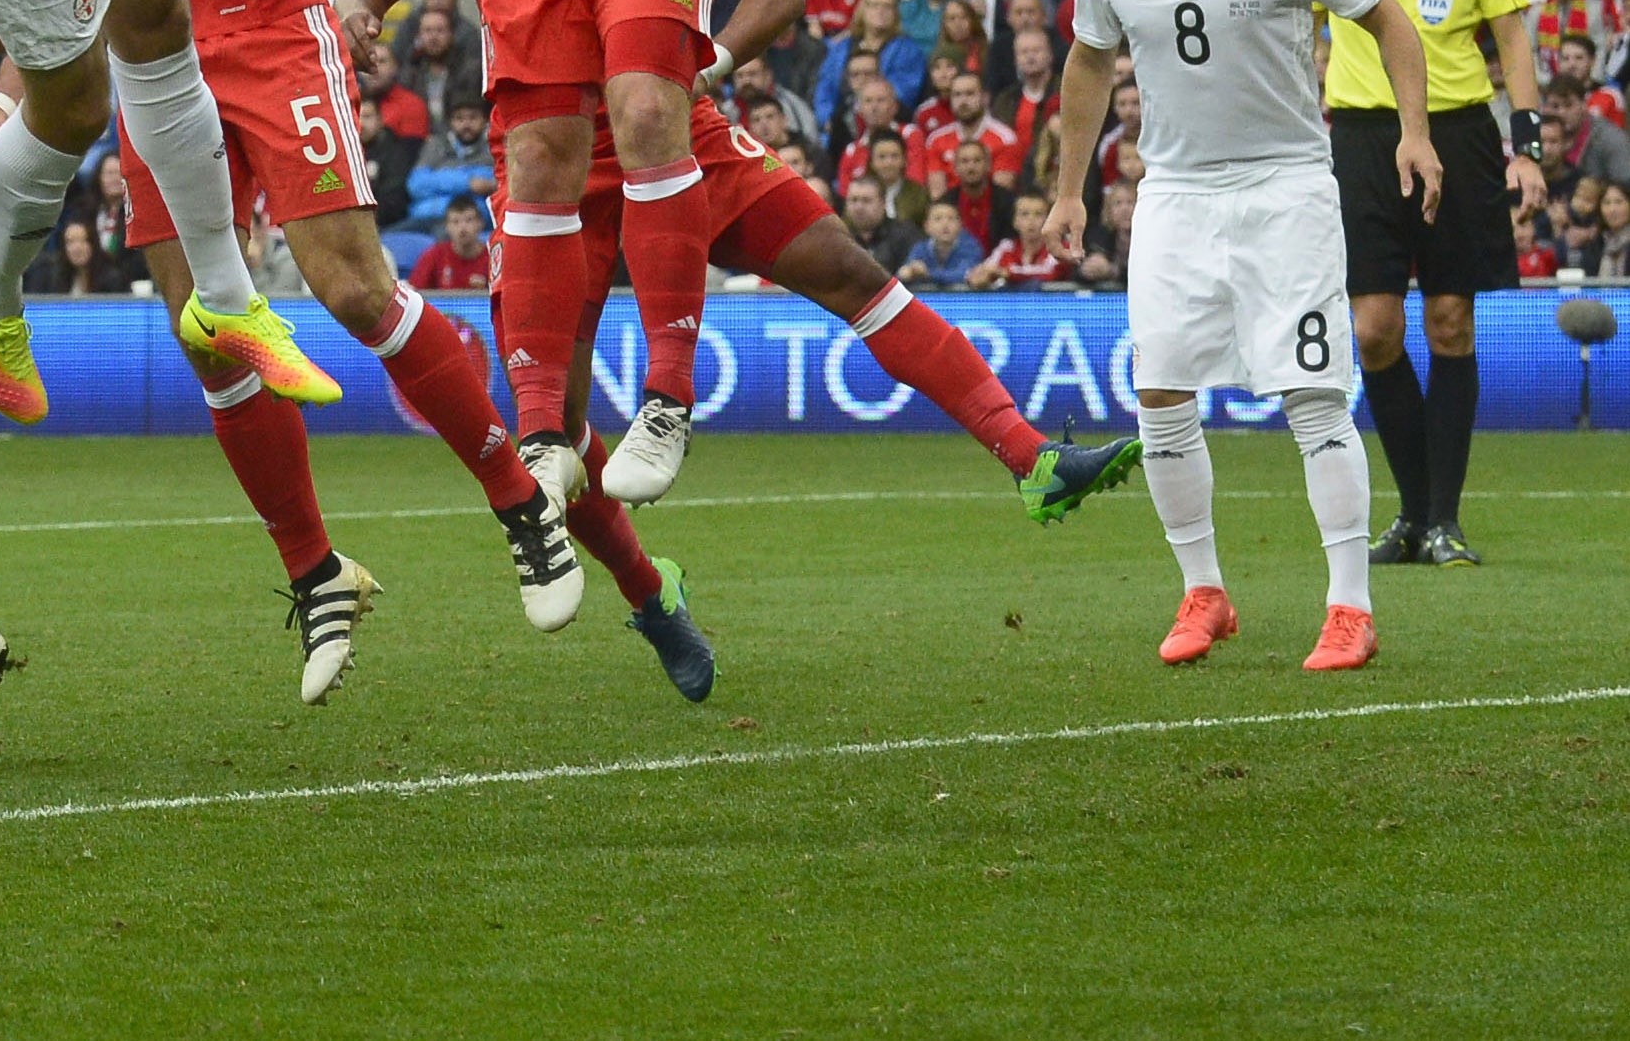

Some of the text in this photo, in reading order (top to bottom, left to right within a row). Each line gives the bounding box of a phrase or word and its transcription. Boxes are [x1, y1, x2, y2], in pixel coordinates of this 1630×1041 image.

[1174, 2, 1211, 66] 8
[290, 95, 337, 165] 5
[764, 321, 917, 421] TO
[1296, 311, 1331, 373] 8
